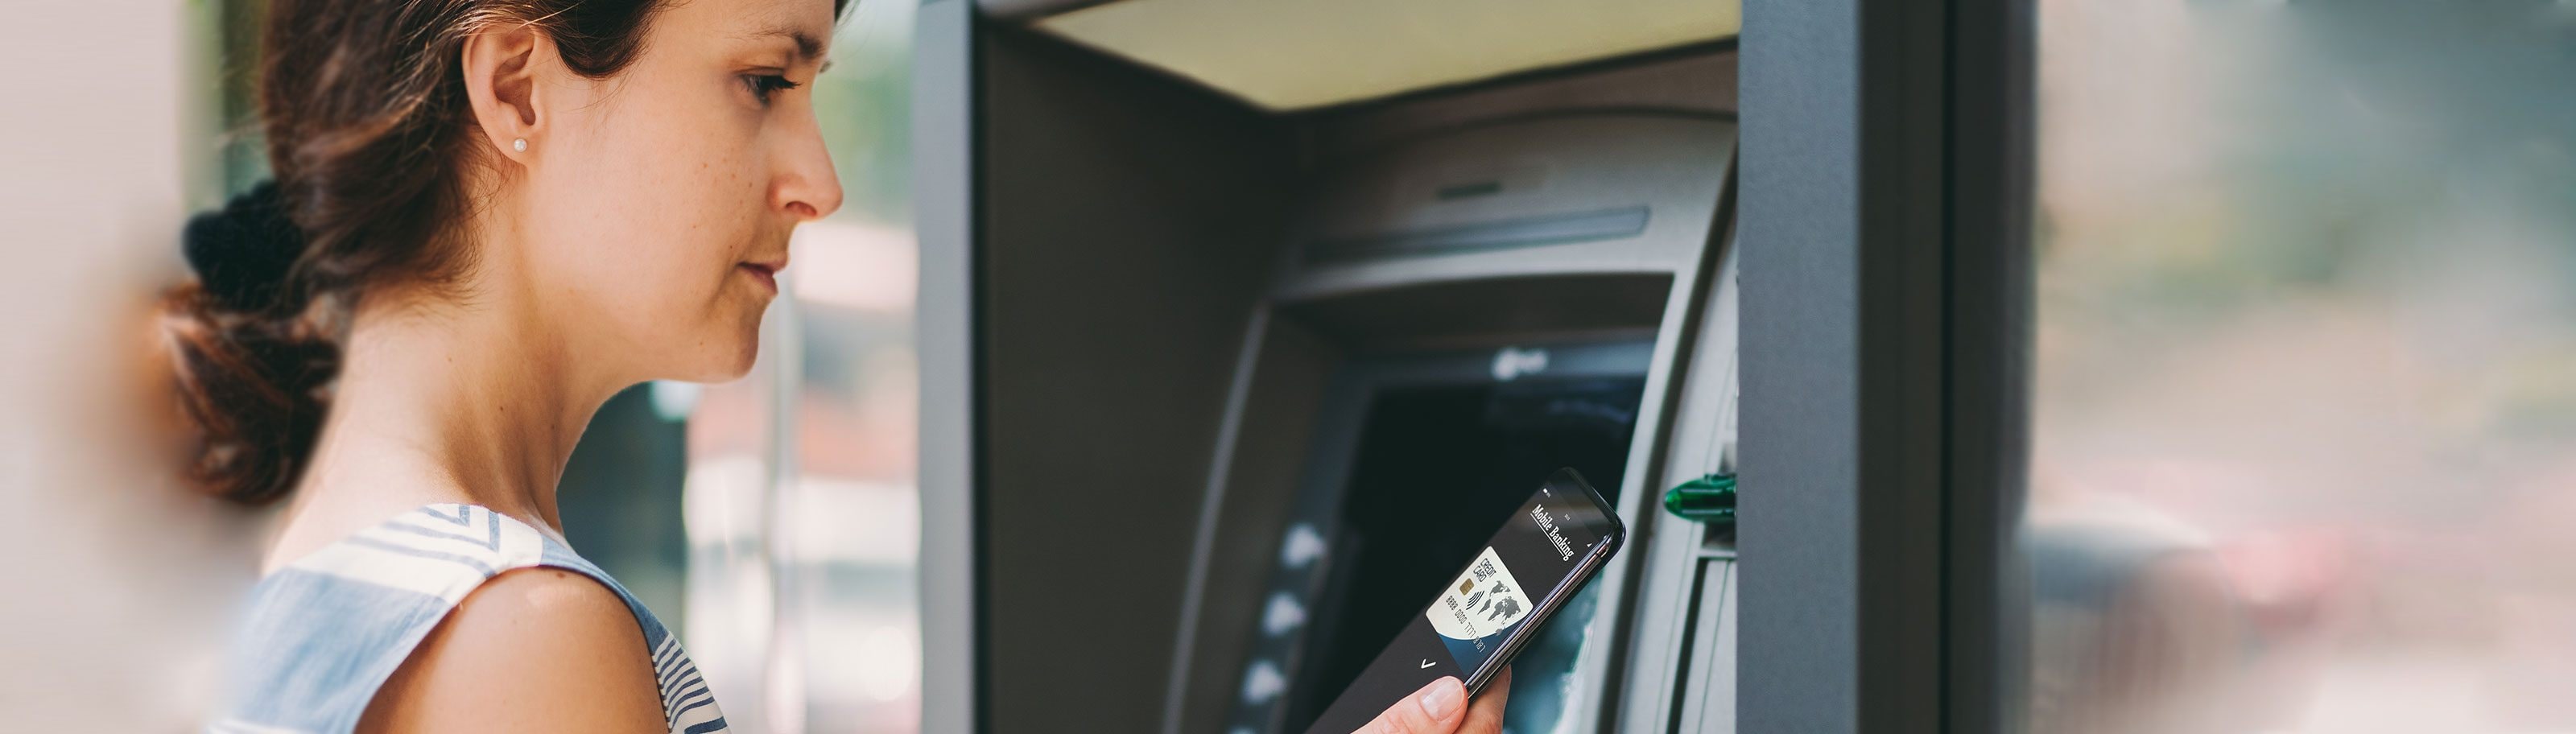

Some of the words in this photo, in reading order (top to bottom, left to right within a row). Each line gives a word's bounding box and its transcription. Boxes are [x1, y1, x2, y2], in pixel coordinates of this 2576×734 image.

[1532, 504, 1553, 531] Mobile
[1549, 526, 1574, 561] Banking
[1473, 565, 1487, 582] CARD
[1480, 558, 1496, 578] CREDIT
[1446, 596, 1459, 611] 8888
[1455, 609, 1468, 625] 0000
[1464, 622, 1476, 638] 7777
[1473, 636, 1486, 653] 8787
